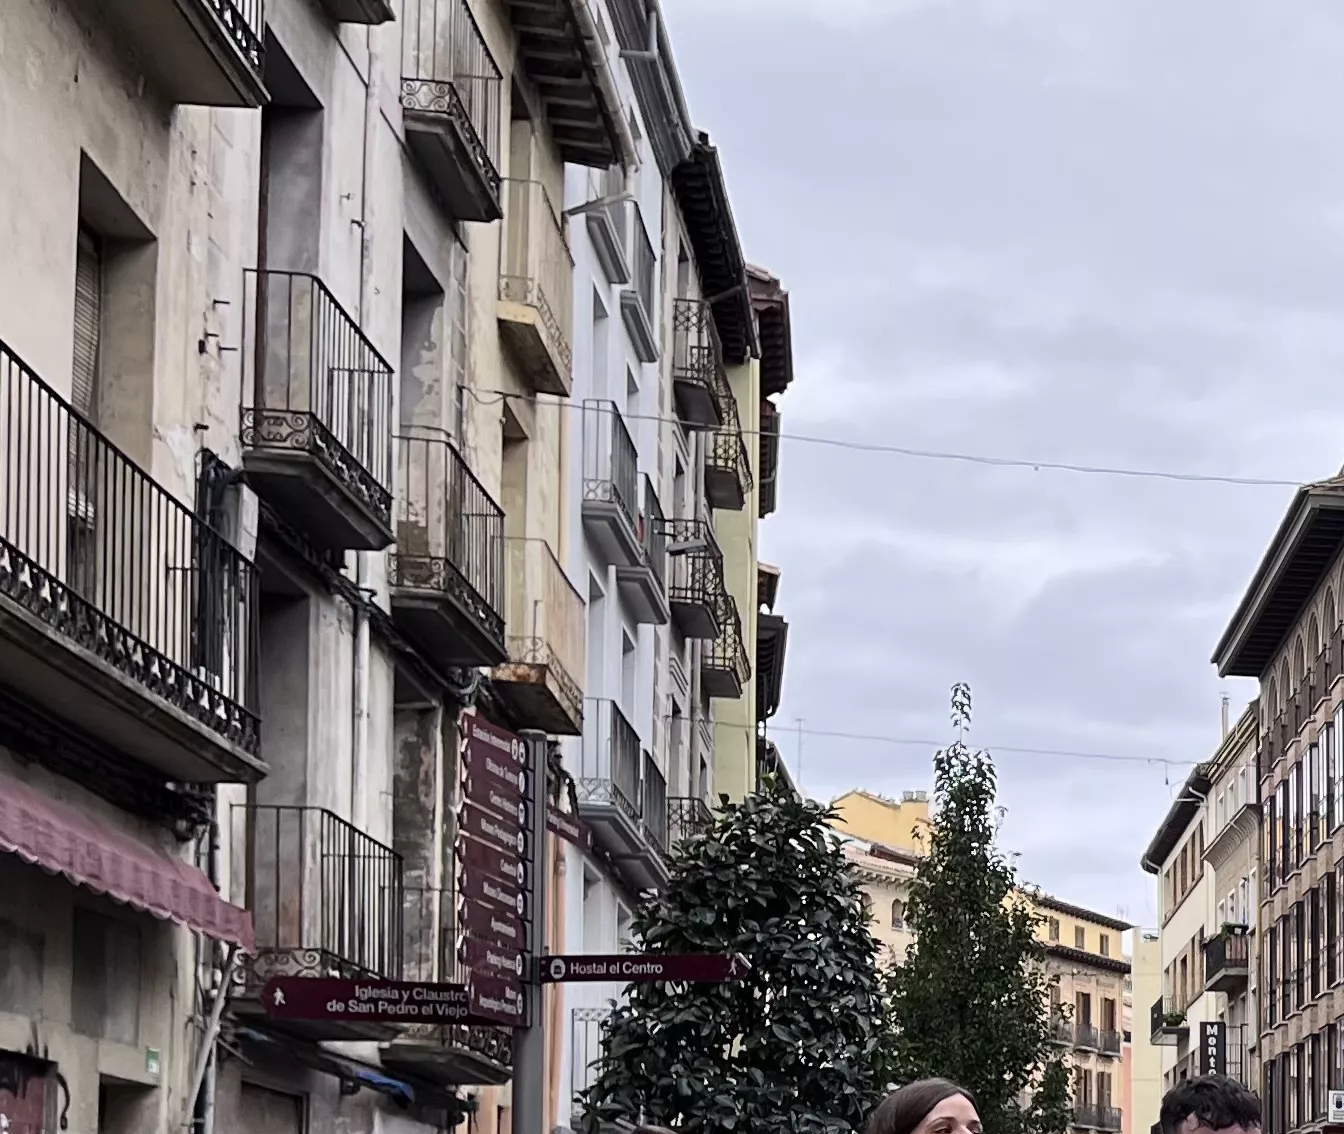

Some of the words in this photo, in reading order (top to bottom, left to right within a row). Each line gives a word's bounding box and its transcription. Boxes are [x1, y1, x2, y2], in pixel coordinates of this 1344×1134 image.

[570, 961, 607, 975] Hostal
[609, 961, 620, 975] el
[622, 961, 664, 975] Centro
[354, 984, 400, 1001] Iglesia
[401, 989, 410, 1004] y
[326, 999, 345, 1013] de
[347, 999, 375, 1014] San
[377, 1000, 419, 1015] Pedro
[421, 1002, 434, 1016] el
[435, 1003, 468, 1020] Viejo
